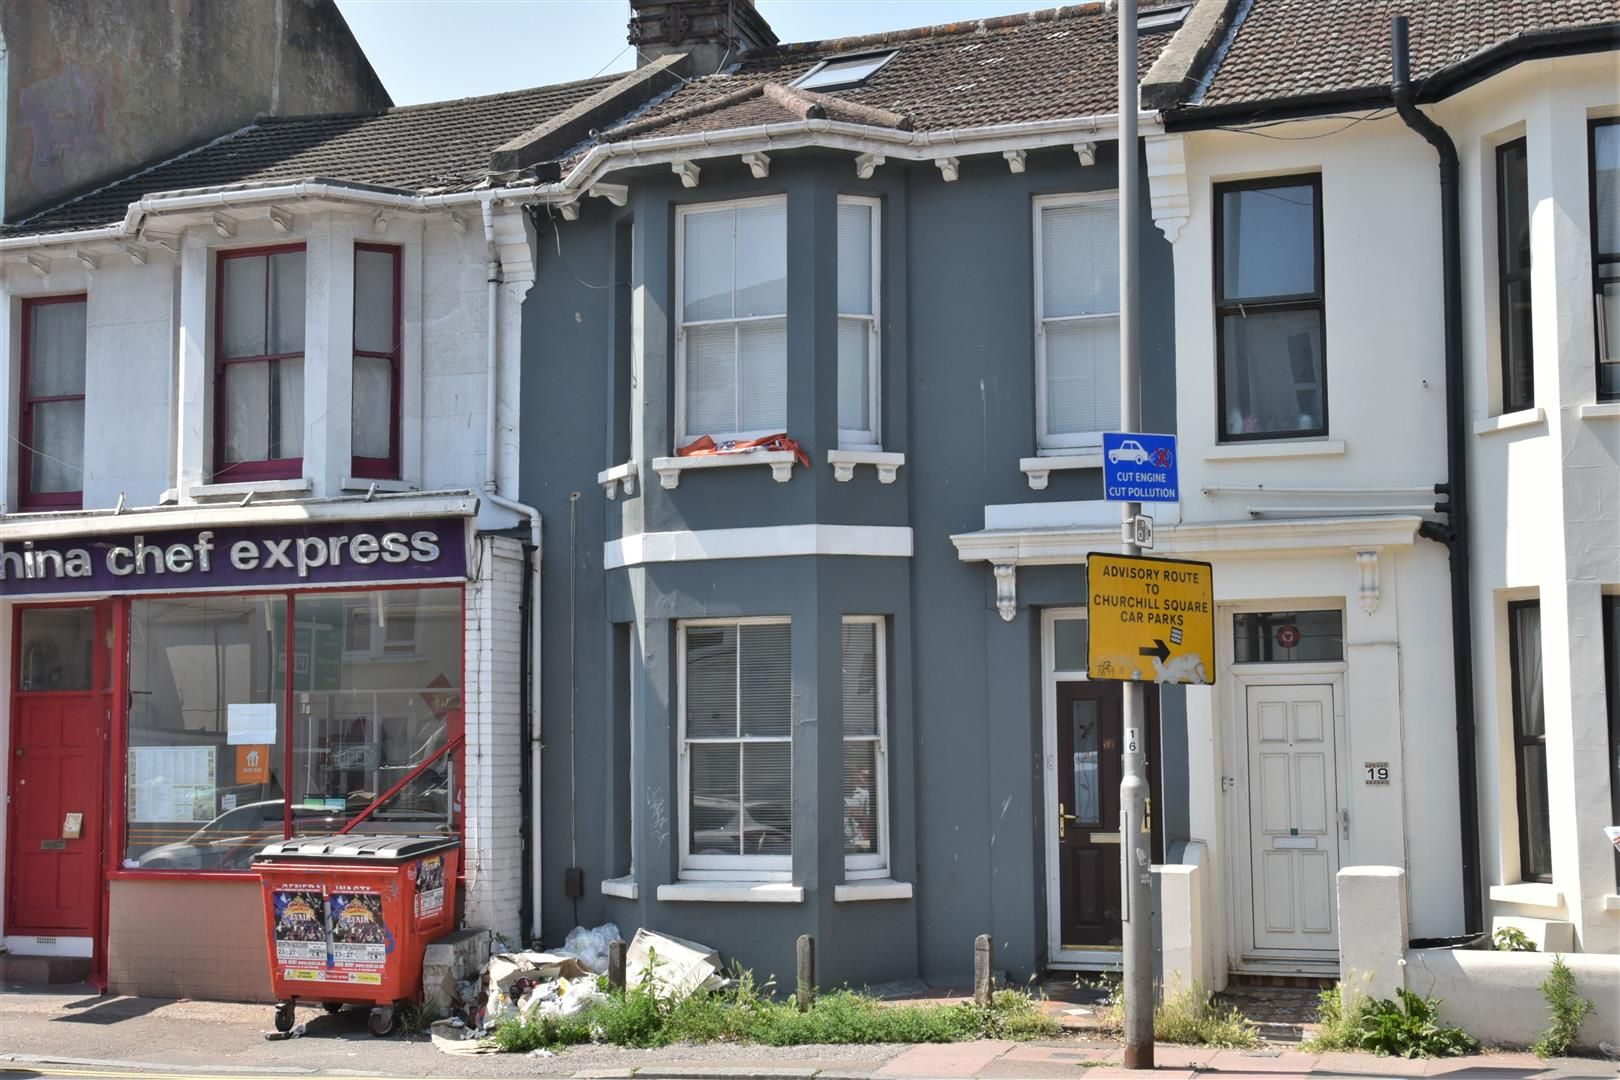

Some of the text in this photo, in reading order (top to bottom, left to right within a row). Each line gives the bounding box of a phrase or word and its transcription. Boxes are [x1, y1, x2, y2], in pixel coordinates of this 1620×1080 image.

[1116, 471, 1167, 483] CUT ENGINE
[1109, 486, 1176, 498] CUT POLLUTION
[106, 531, 215, 576] chef
[230, 531, 441, 577] express
[1103, 565, 1199, 584] ADVISORY ROUTE
[1145, 583, 1160, 595] TO
[1093, 594, 1209, 613] CHURCHILL SQUARE
[1120, 610, 1184, 626] CAR PARKS
[1367, 767, 1389, 780] 19
